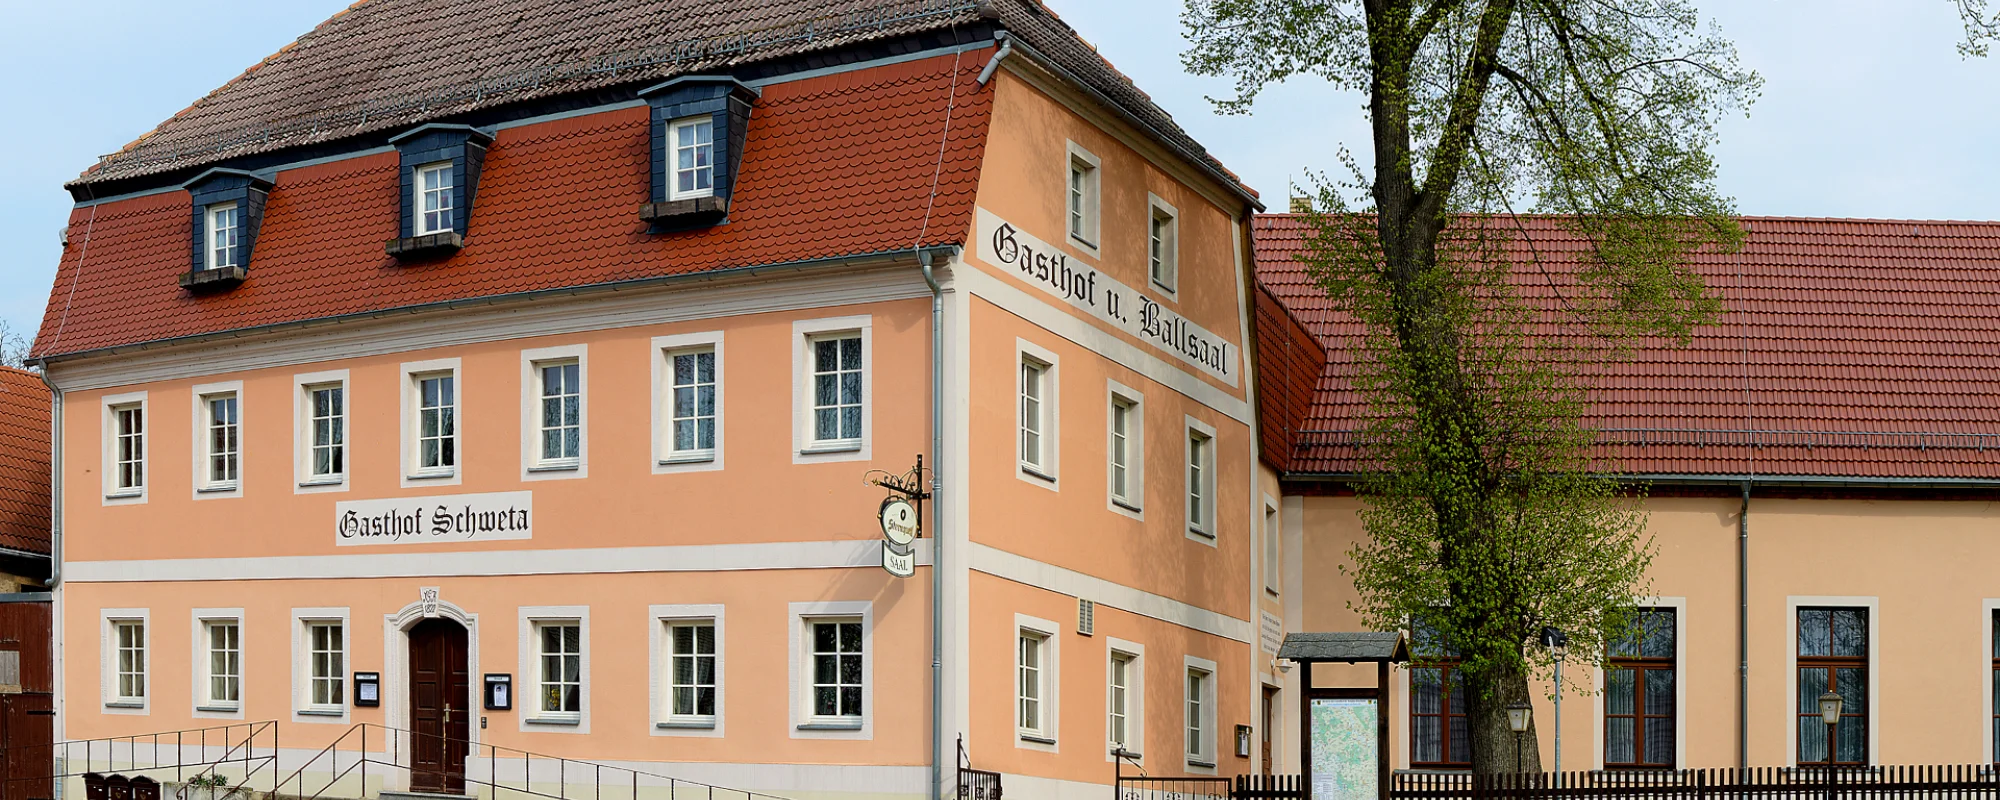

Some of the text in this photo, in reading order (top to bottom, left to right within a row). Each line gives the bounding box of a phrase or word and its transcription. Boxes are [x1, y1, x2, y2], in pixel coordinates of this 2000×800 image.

[993, 222, 1228, 375] Gasthof u. Ballsaal
[339, 504, 529, 542] Gasthof Schweta
[889, 555, 908, 571] SAAL
